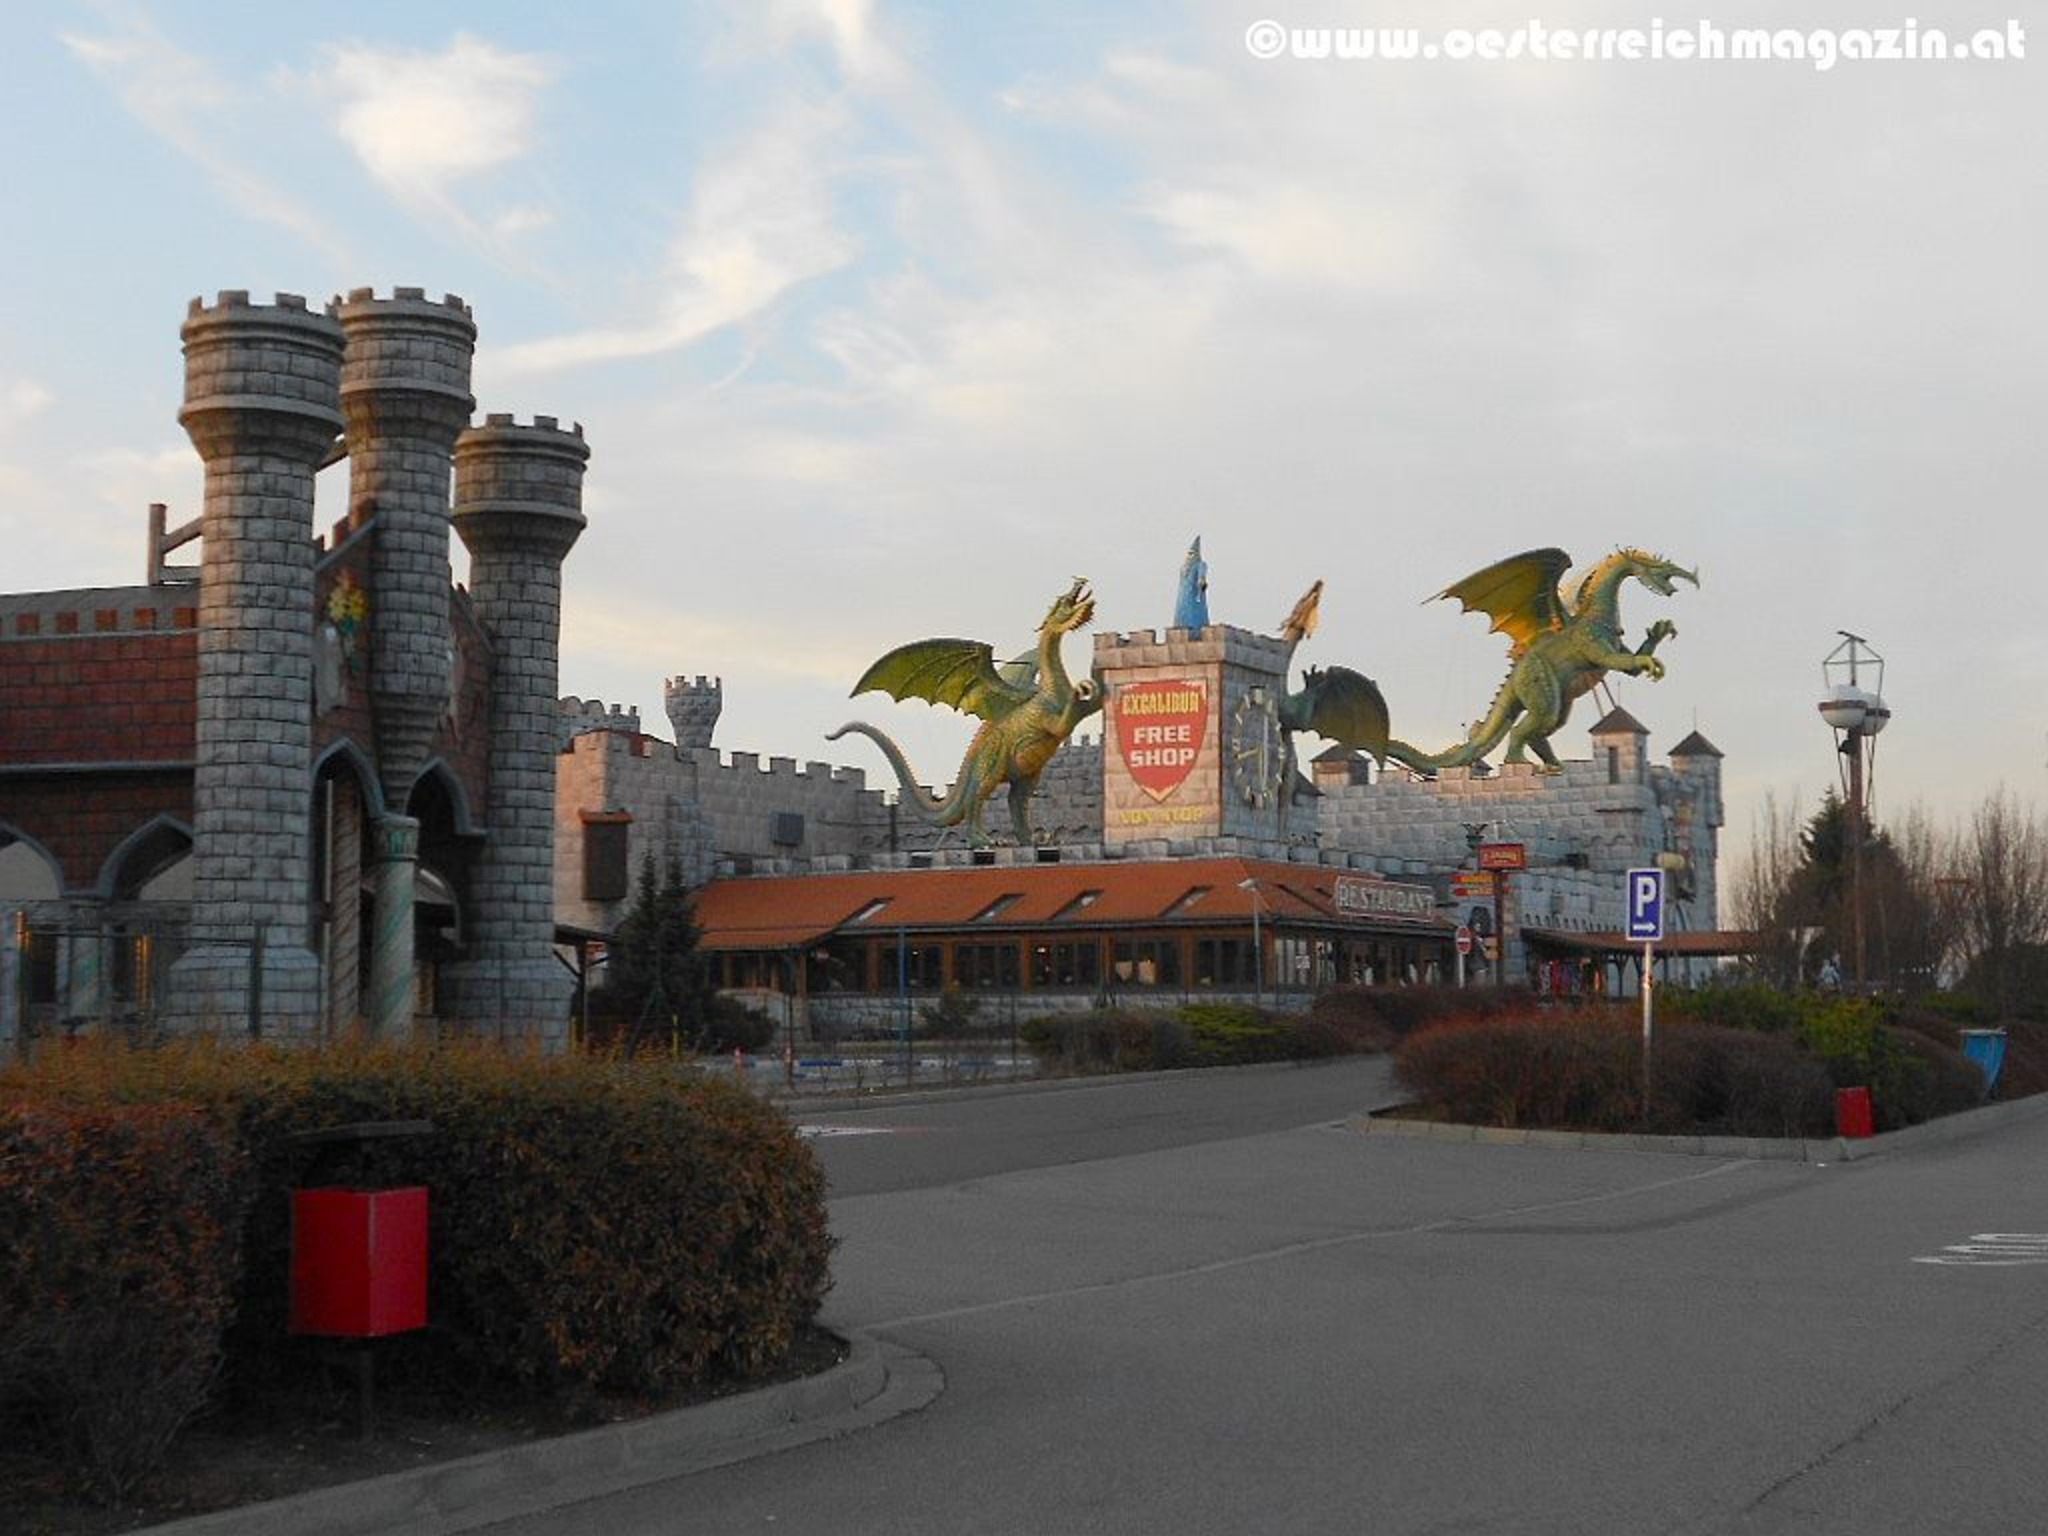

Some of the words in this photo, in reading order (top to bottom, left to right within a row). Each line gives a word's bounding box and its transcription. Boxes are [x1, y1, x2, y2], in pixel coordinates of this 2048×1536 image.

[1121, 691, 1199, 715] EXCALIBUR
[1133, 725, 1191, 744] FREE
[1130, 748, 1195, 767] SHOP
[1635, 877, 1657, 918] P
